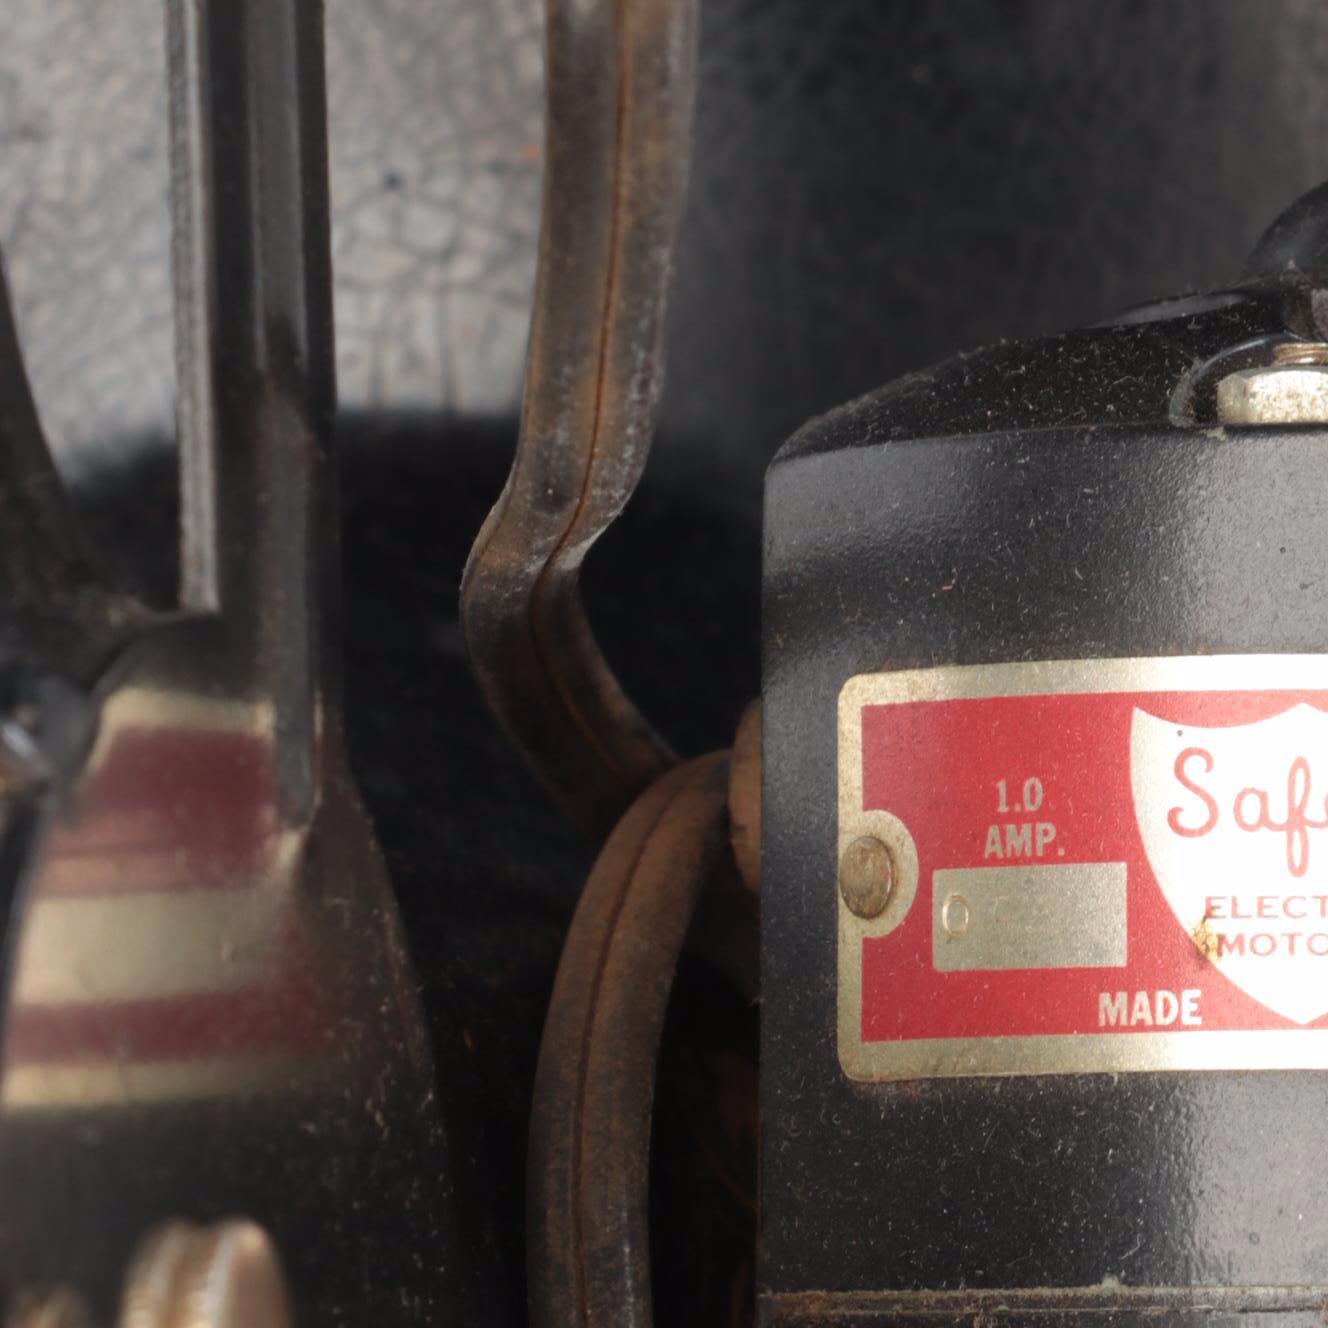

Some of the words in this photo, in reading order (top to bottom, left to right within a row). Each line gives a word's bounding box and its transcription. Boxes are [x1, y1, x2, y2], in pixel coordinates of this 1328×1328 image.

[996, 776, 1043, 814] 1.0
[983, 823, 1066, 859] AMP.
[1098, 989, 1203, 1027] MADE
